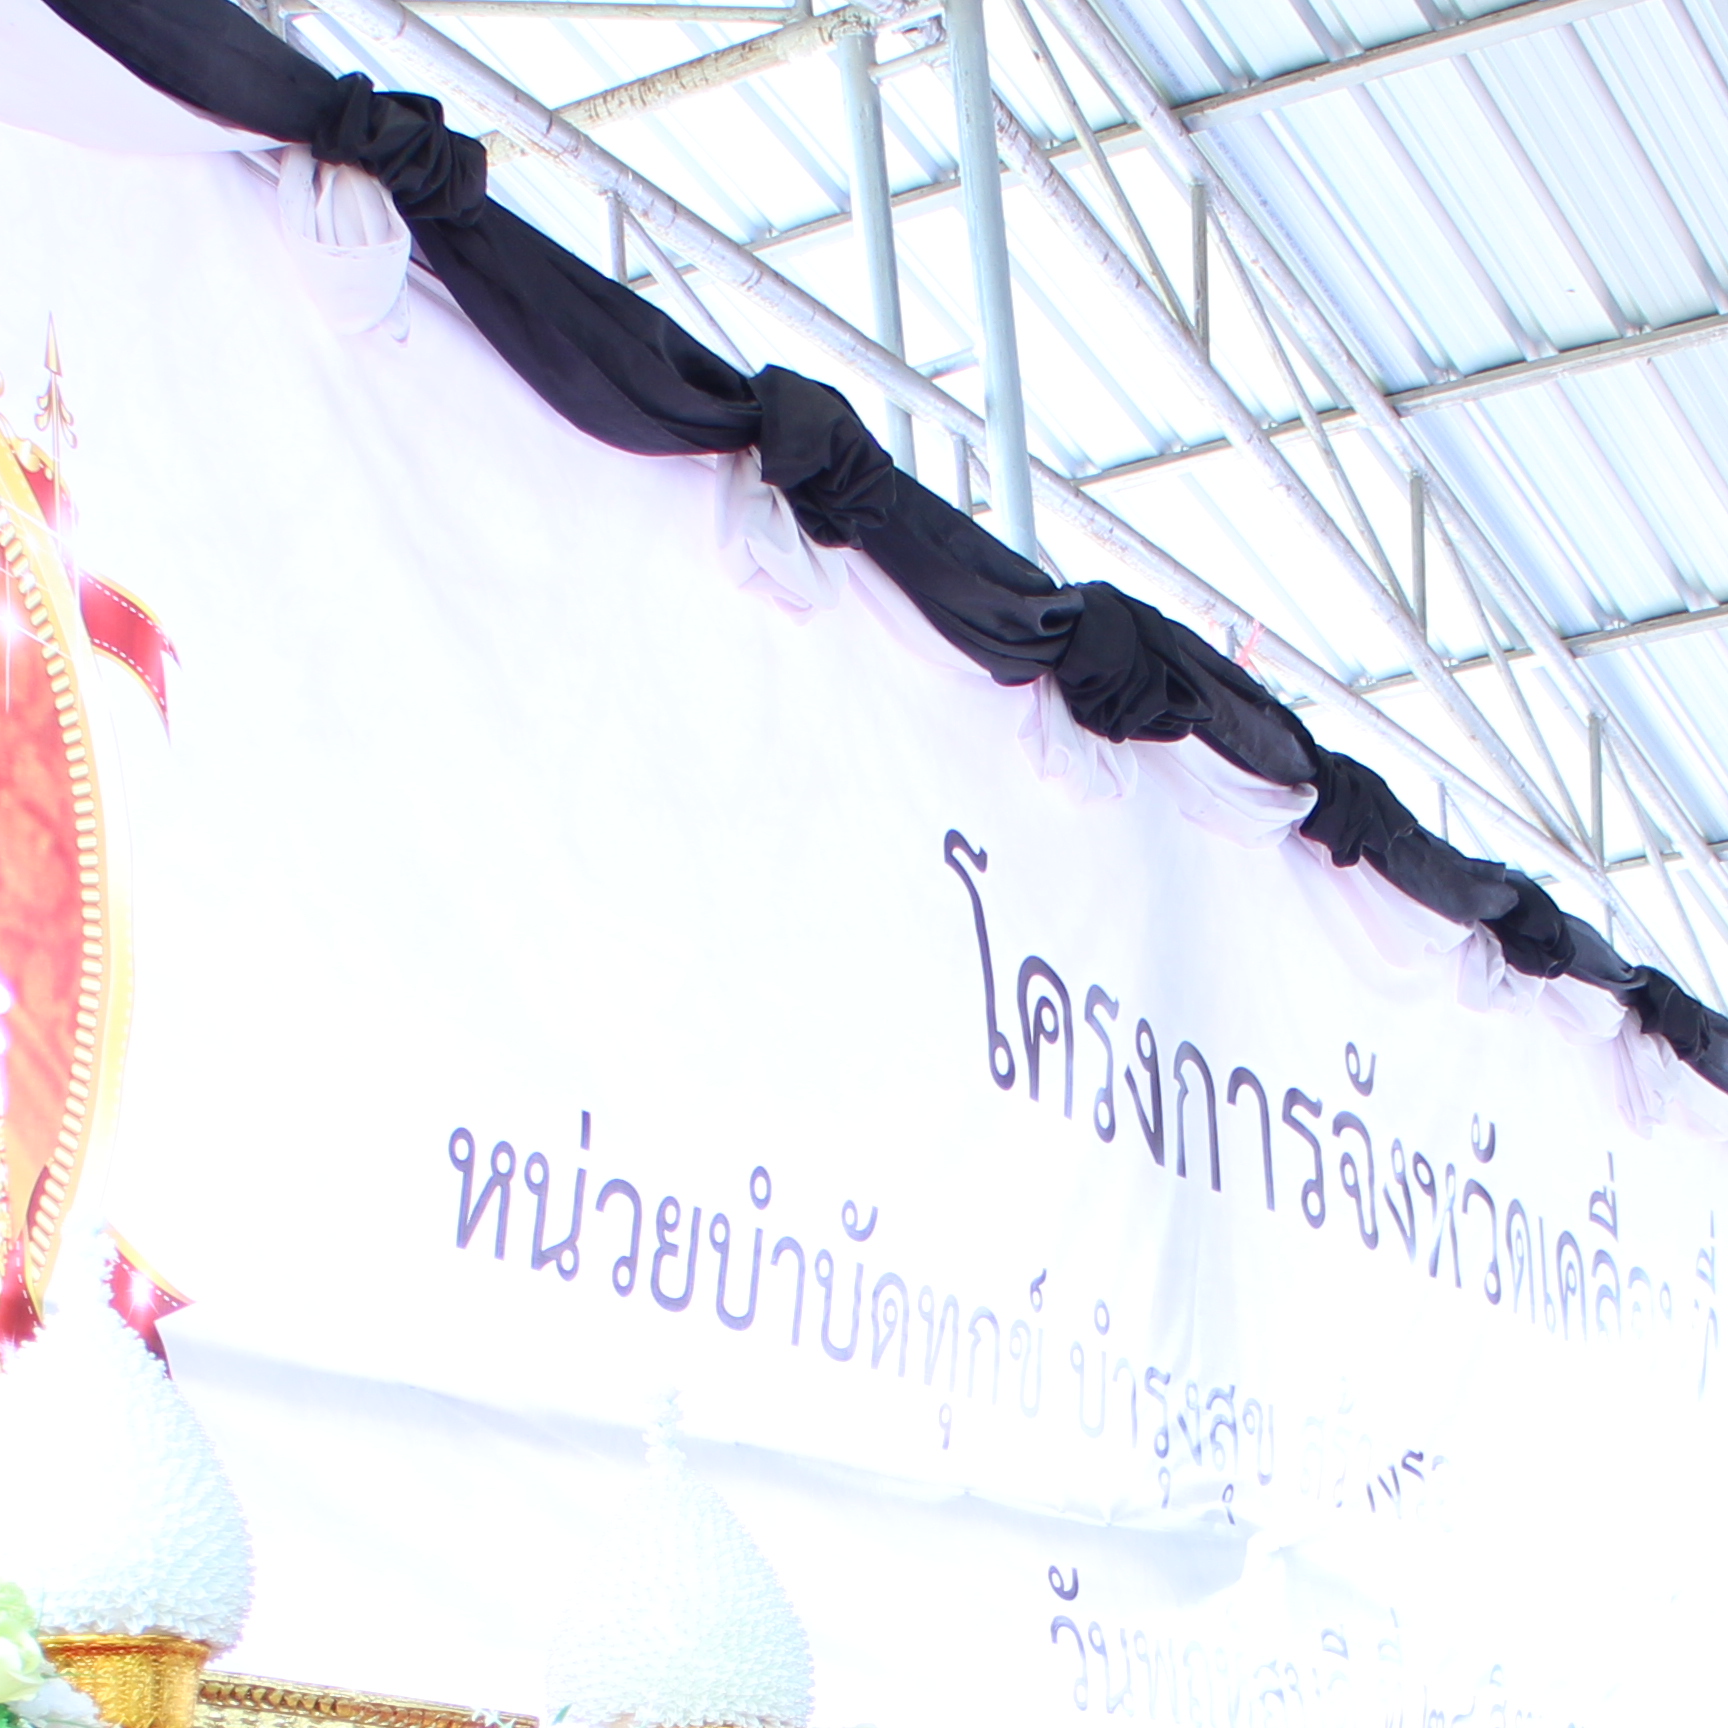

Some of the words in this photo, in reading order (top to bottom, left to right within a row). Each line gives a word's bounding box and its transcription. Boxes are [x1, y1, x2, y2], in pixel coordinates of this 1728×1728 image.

[447, 1109, 1048, 1450] หน่วยบำบัดทุกข์
[1070, 1299, 1275, 1526] บำรุงสุข
